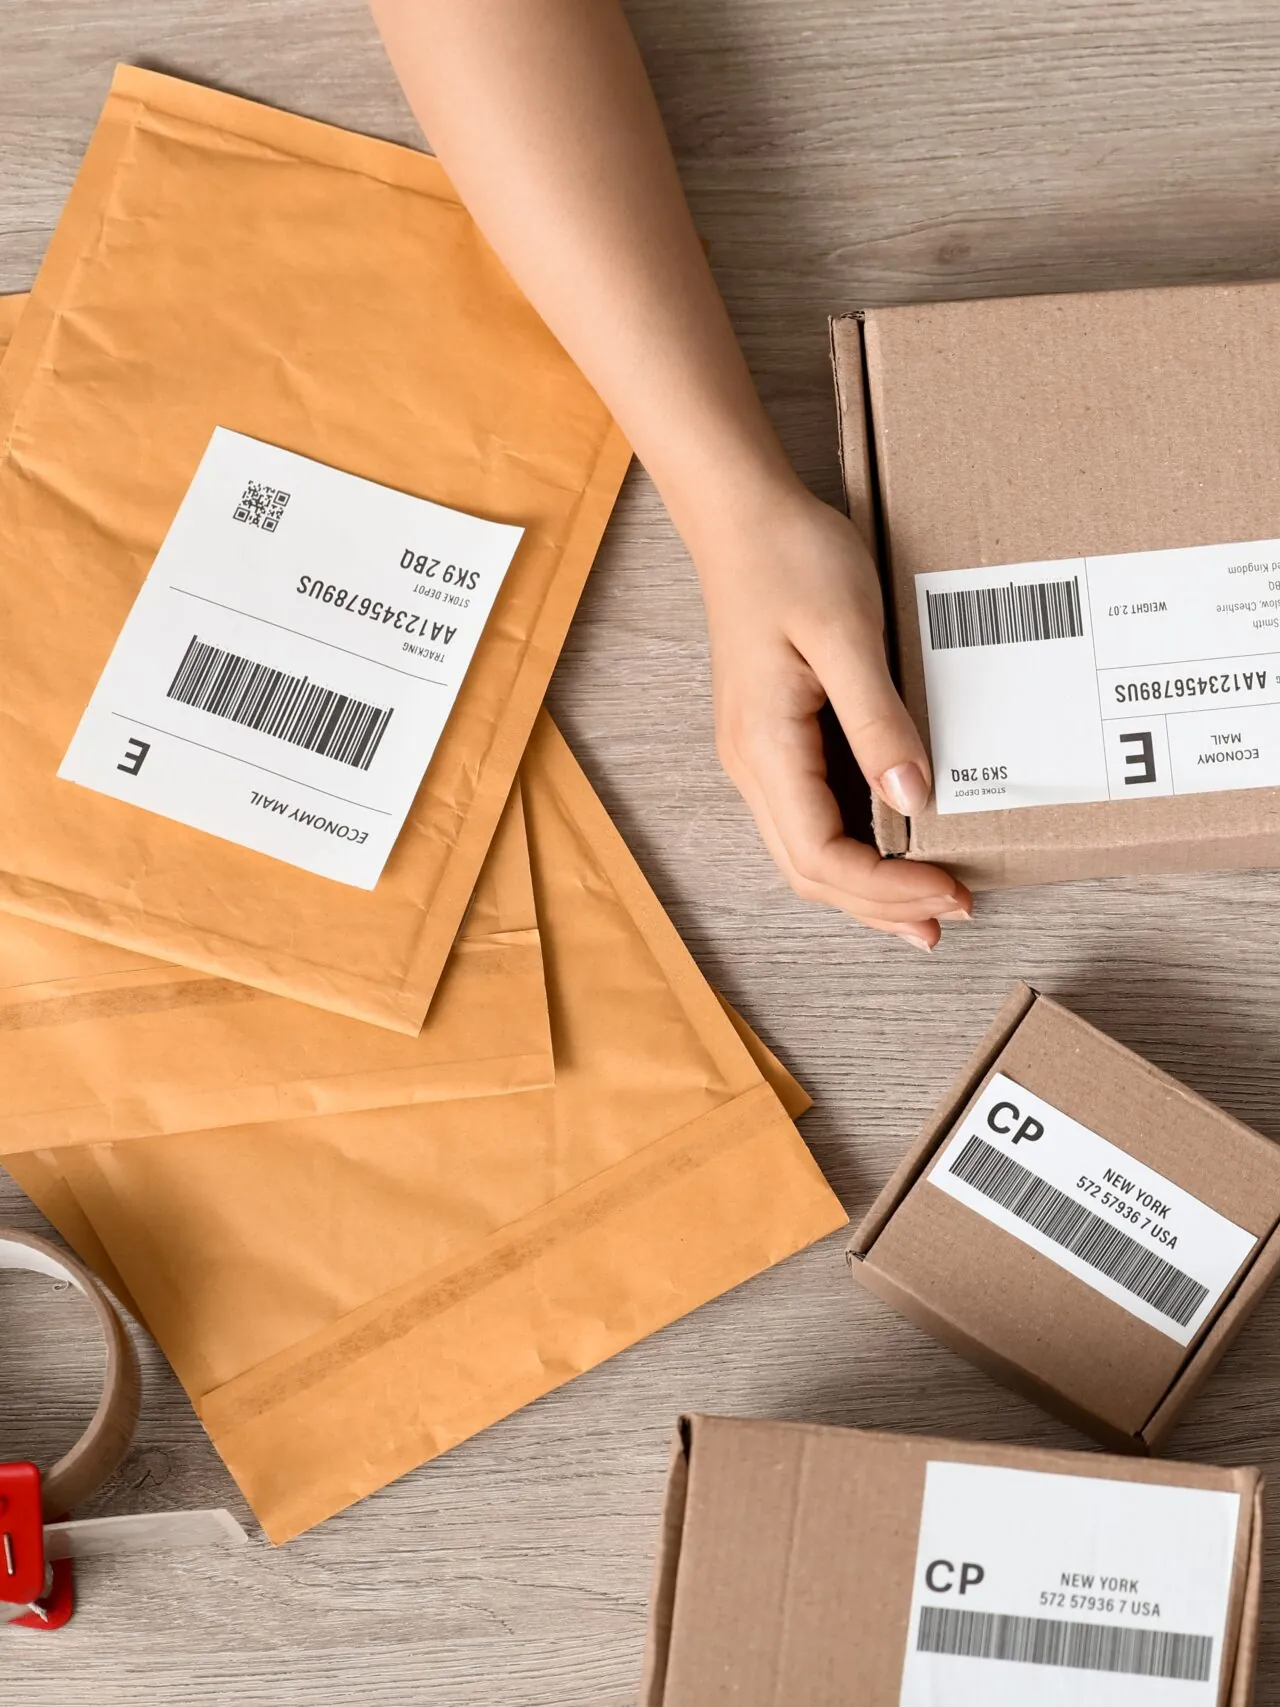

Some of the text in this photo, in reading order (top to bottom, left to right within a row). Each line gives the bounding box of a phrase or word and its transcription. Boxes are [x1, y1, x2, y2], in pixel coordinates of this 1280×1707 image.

[400, 549, 480, 590] SK9 2BQ
[1228, 563, 1268, 575] Kingdom
[413, 584, 470, 608] STOKE DEPOT
[1216, 602, 1256, 614] Cheshire
[297, 576, 457, 644] AA123456789US
[1109, 602, 1167, 616] WEIGHT 2.07
[1253, 618, 1279, 629] Smith
[403, 642, 444, 662] TRACKING
[1115, 671, 1266, 702] AA123456789US
[1211, 733, 1241, 745] MAIL
[117, 738, 150, 776] E
[1120, 732, 1156, 785] E
[1198, 749, 1259, 764] ECONOMY
[951, 766, 1007, 782] SK9 2BQ
[955, 787, 1006, 797] STOKE DEPOT
[251, 791, 368, 844] ECONOMY MAIL
[987, 1102, 1044, 1144] CP
[1103, 1168, 1171, 1219] NEW YORK
[1077, 1176, 1177, 1249] 572 57936 7 USA
[925, 1560, 984, 1595] CP
[1061, 1573, 1138, 1593] NEW YORK
[1040, 1592, 1160, 1616] 572 57936 7 USA
